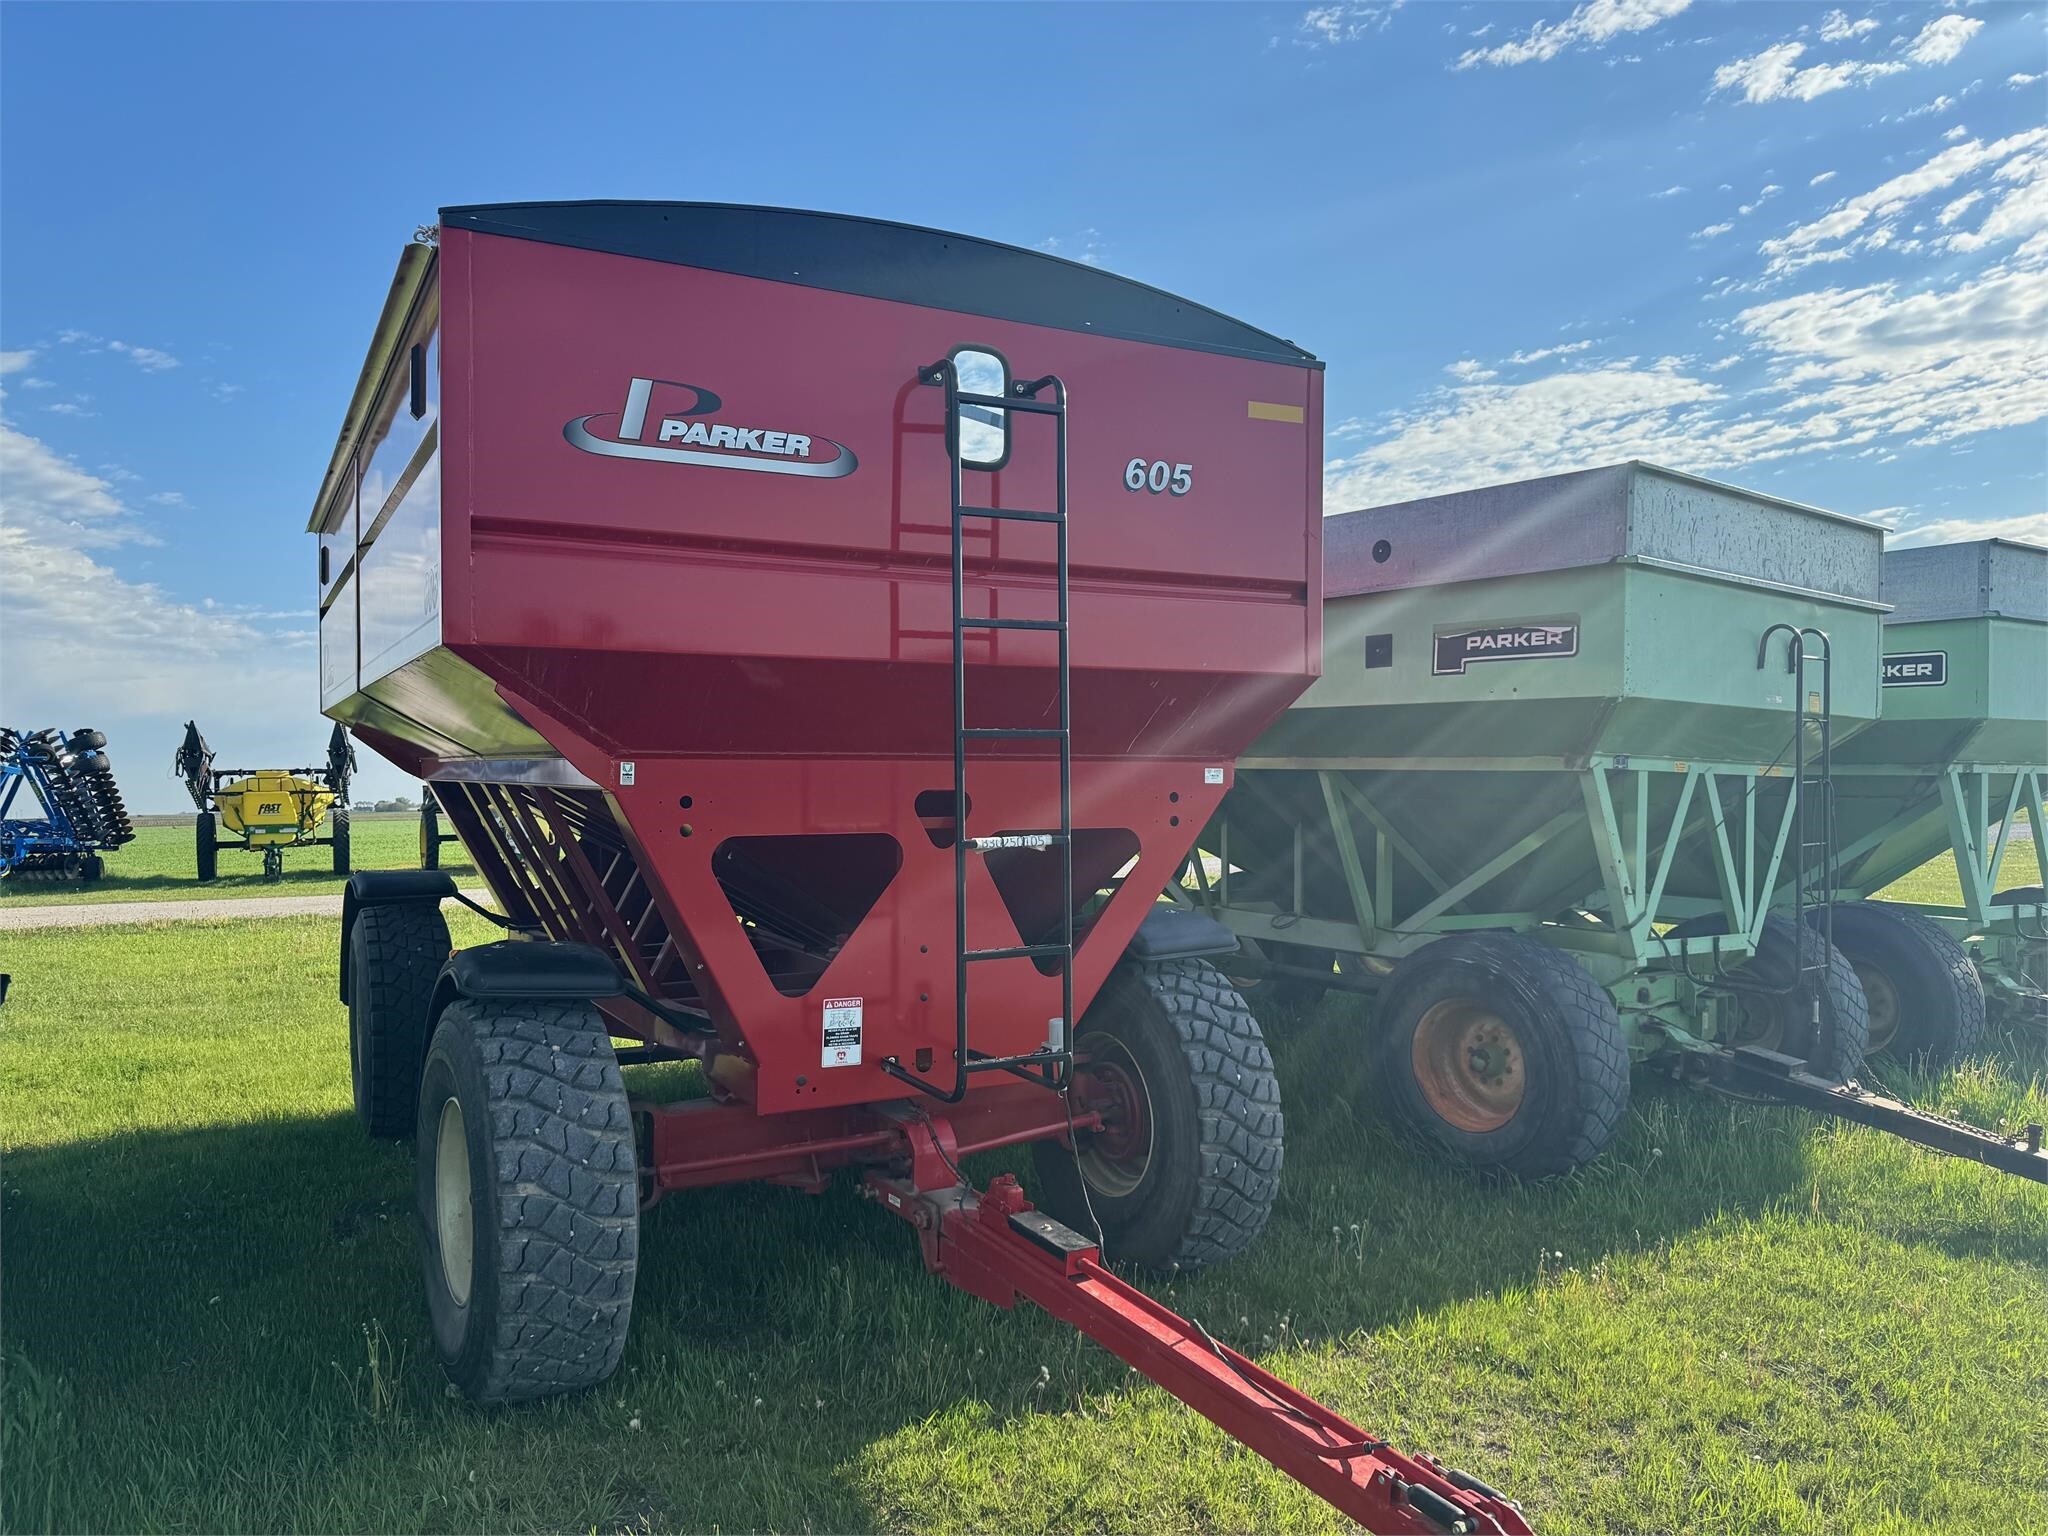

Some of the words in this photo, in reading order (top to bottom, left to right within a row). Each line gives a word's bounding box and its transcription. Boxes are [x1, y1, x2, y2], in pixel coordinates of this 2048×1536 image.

[658, 418, 811, 458] PARKER
[1123, 457, 1193, 497] 605
[1466, 631, 1562, 650] PARKER
[1882, 663, 1932, 677] KER
[258, 803, 282, 815] FAST
[834, 1000, 861, 1008] DANGER
